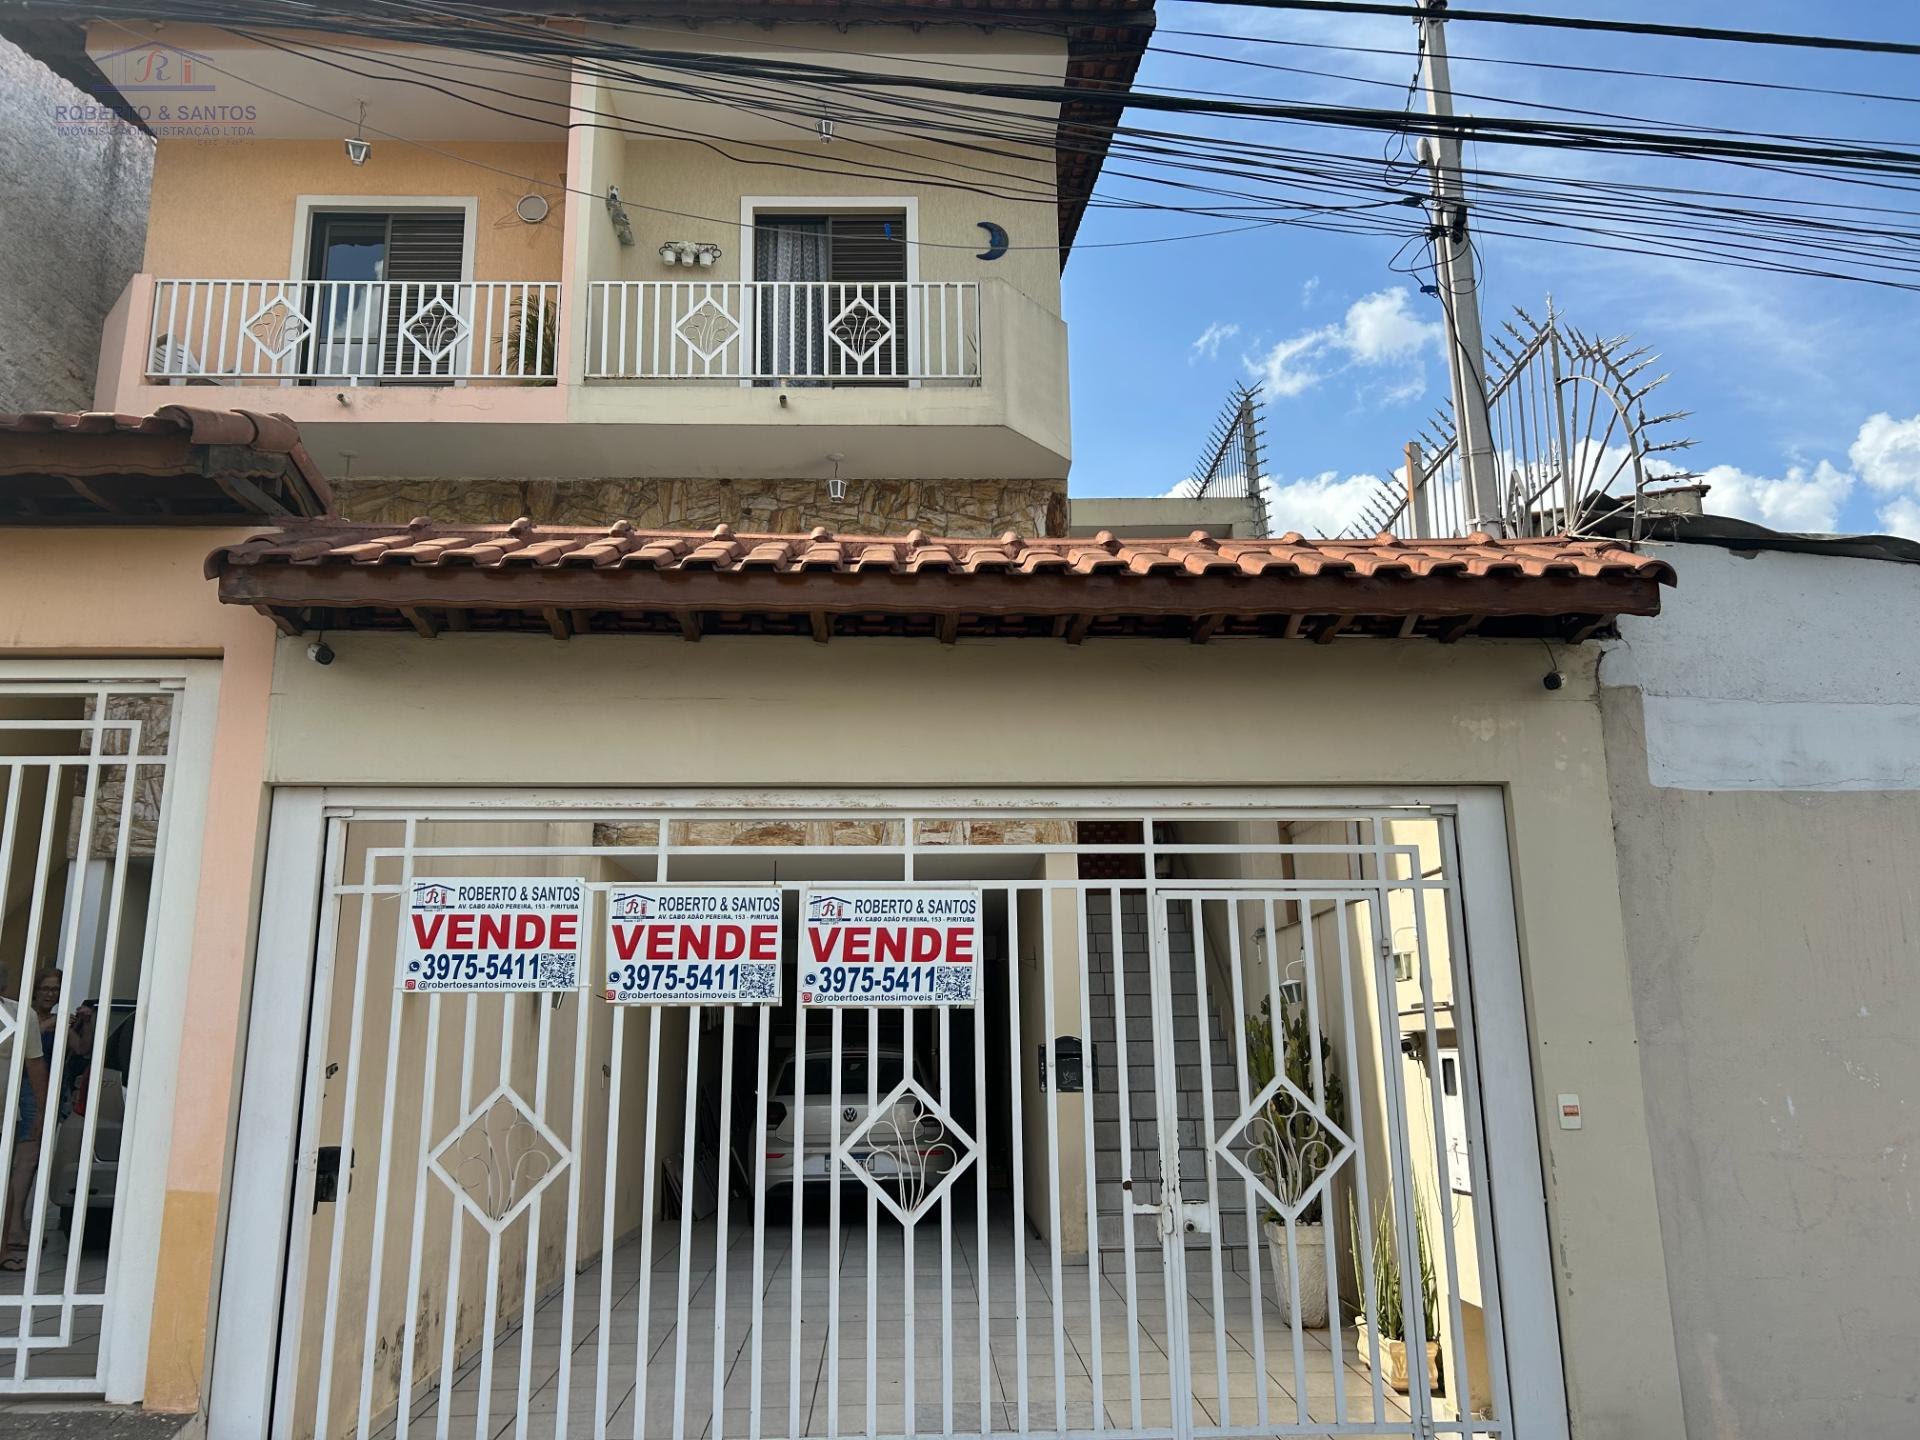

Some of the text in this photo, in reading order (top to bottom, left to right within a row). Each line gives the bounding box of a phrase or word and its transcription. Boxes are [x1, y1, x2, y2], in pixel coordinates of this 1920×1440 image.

[458, 886, 580, 902] ROBERTO & SANTOS
[658, 897, 780, 912] ROBERTO & SANTOS
[854, 899, 976, 915] ROBERTO & SANTOS
[411, 914, 578, 950] VENDE
[611, 925, 778, 961] VENDE
[808, 927, 974, 963] VENDE
[422, 953, 539, 980] 3975-5411
[417, 980, 537, 991] @robertoesantosimoveis
[622, 964, 739, 991] 3975-5411
[818, 966, 935, 993] 3975-5411
[617, 991, 737, 1001] @robertoesantosimoveis
[813, 993, 933, 1004] @robertoesantosimoveis
